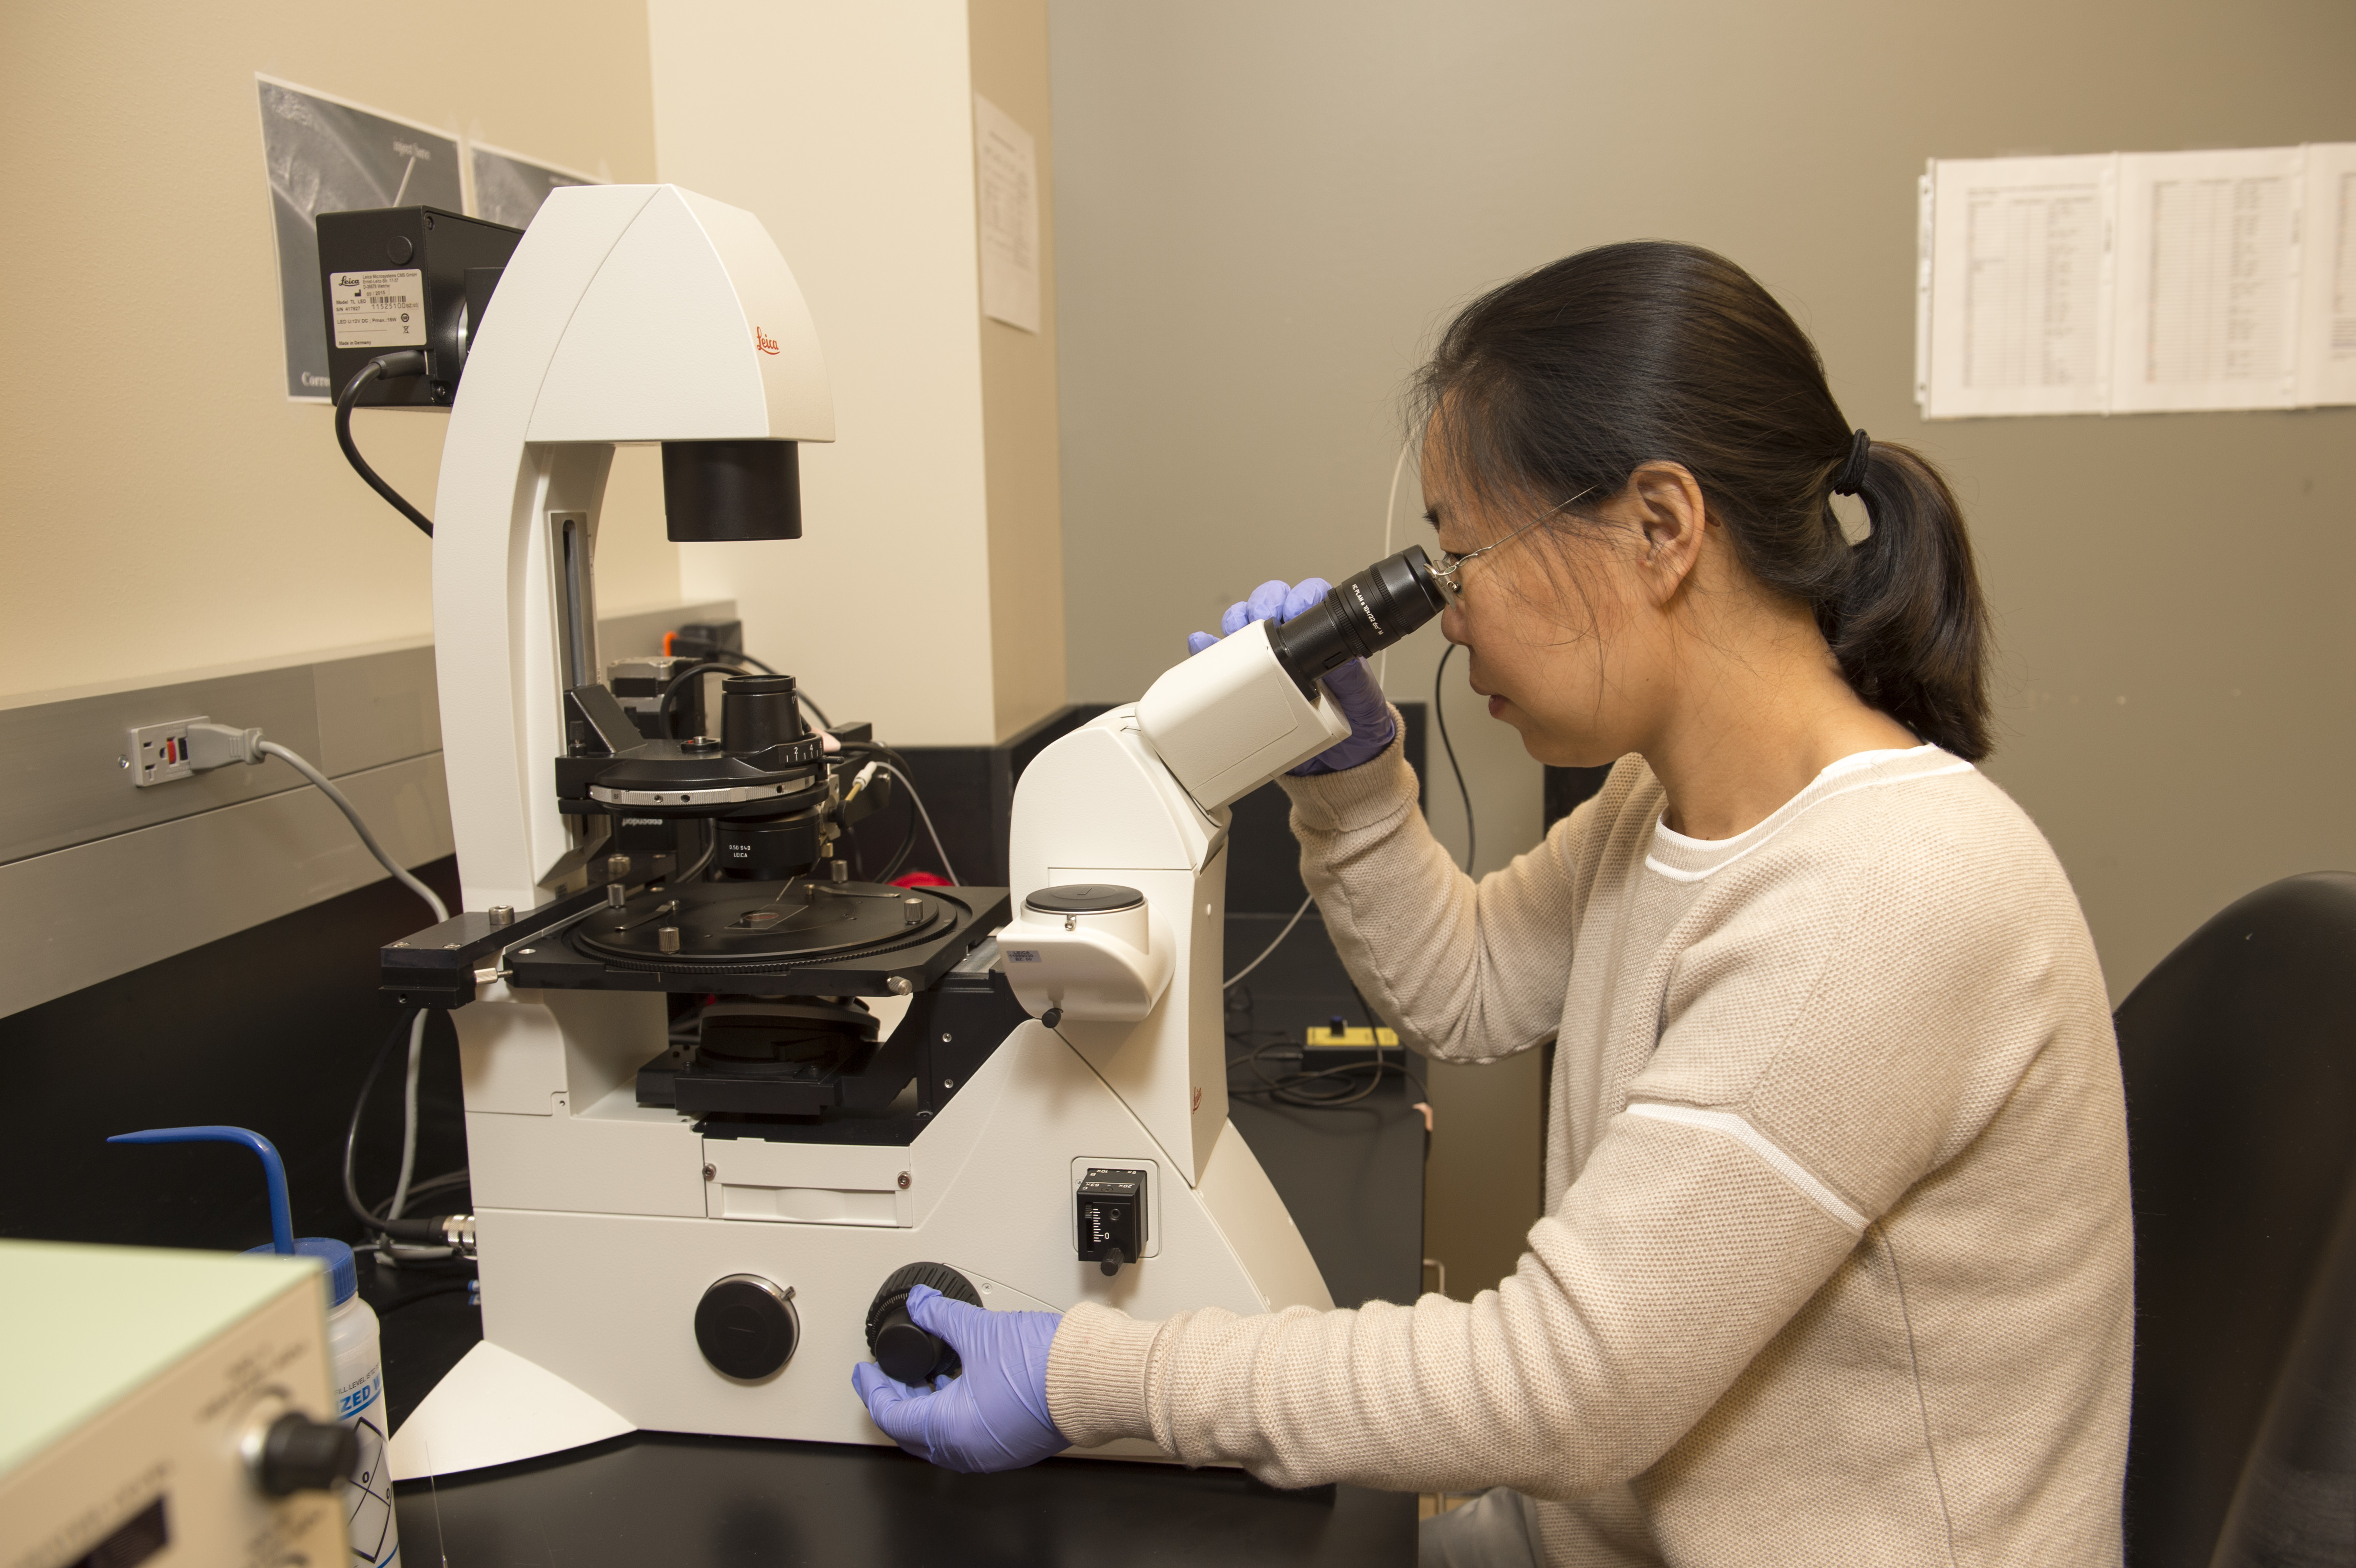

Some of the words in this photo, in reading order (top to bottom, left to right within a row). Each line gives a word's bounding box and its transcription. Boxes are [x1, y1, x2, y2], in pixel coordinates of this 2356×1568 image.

[338, 276, 360, 286] Leica
[756, 326, 780, 355] Leica
[1354, 589, 1364, 602] PLAN
[1363, 605, 1375, 622] 10x/22
[1193, 1087, 1202, 1114] Leica
[349, 1377, 366, 1390] LEVEL
[362, 1471, 370, 1483] 0
[386, 1487, 390, 1499] 0
